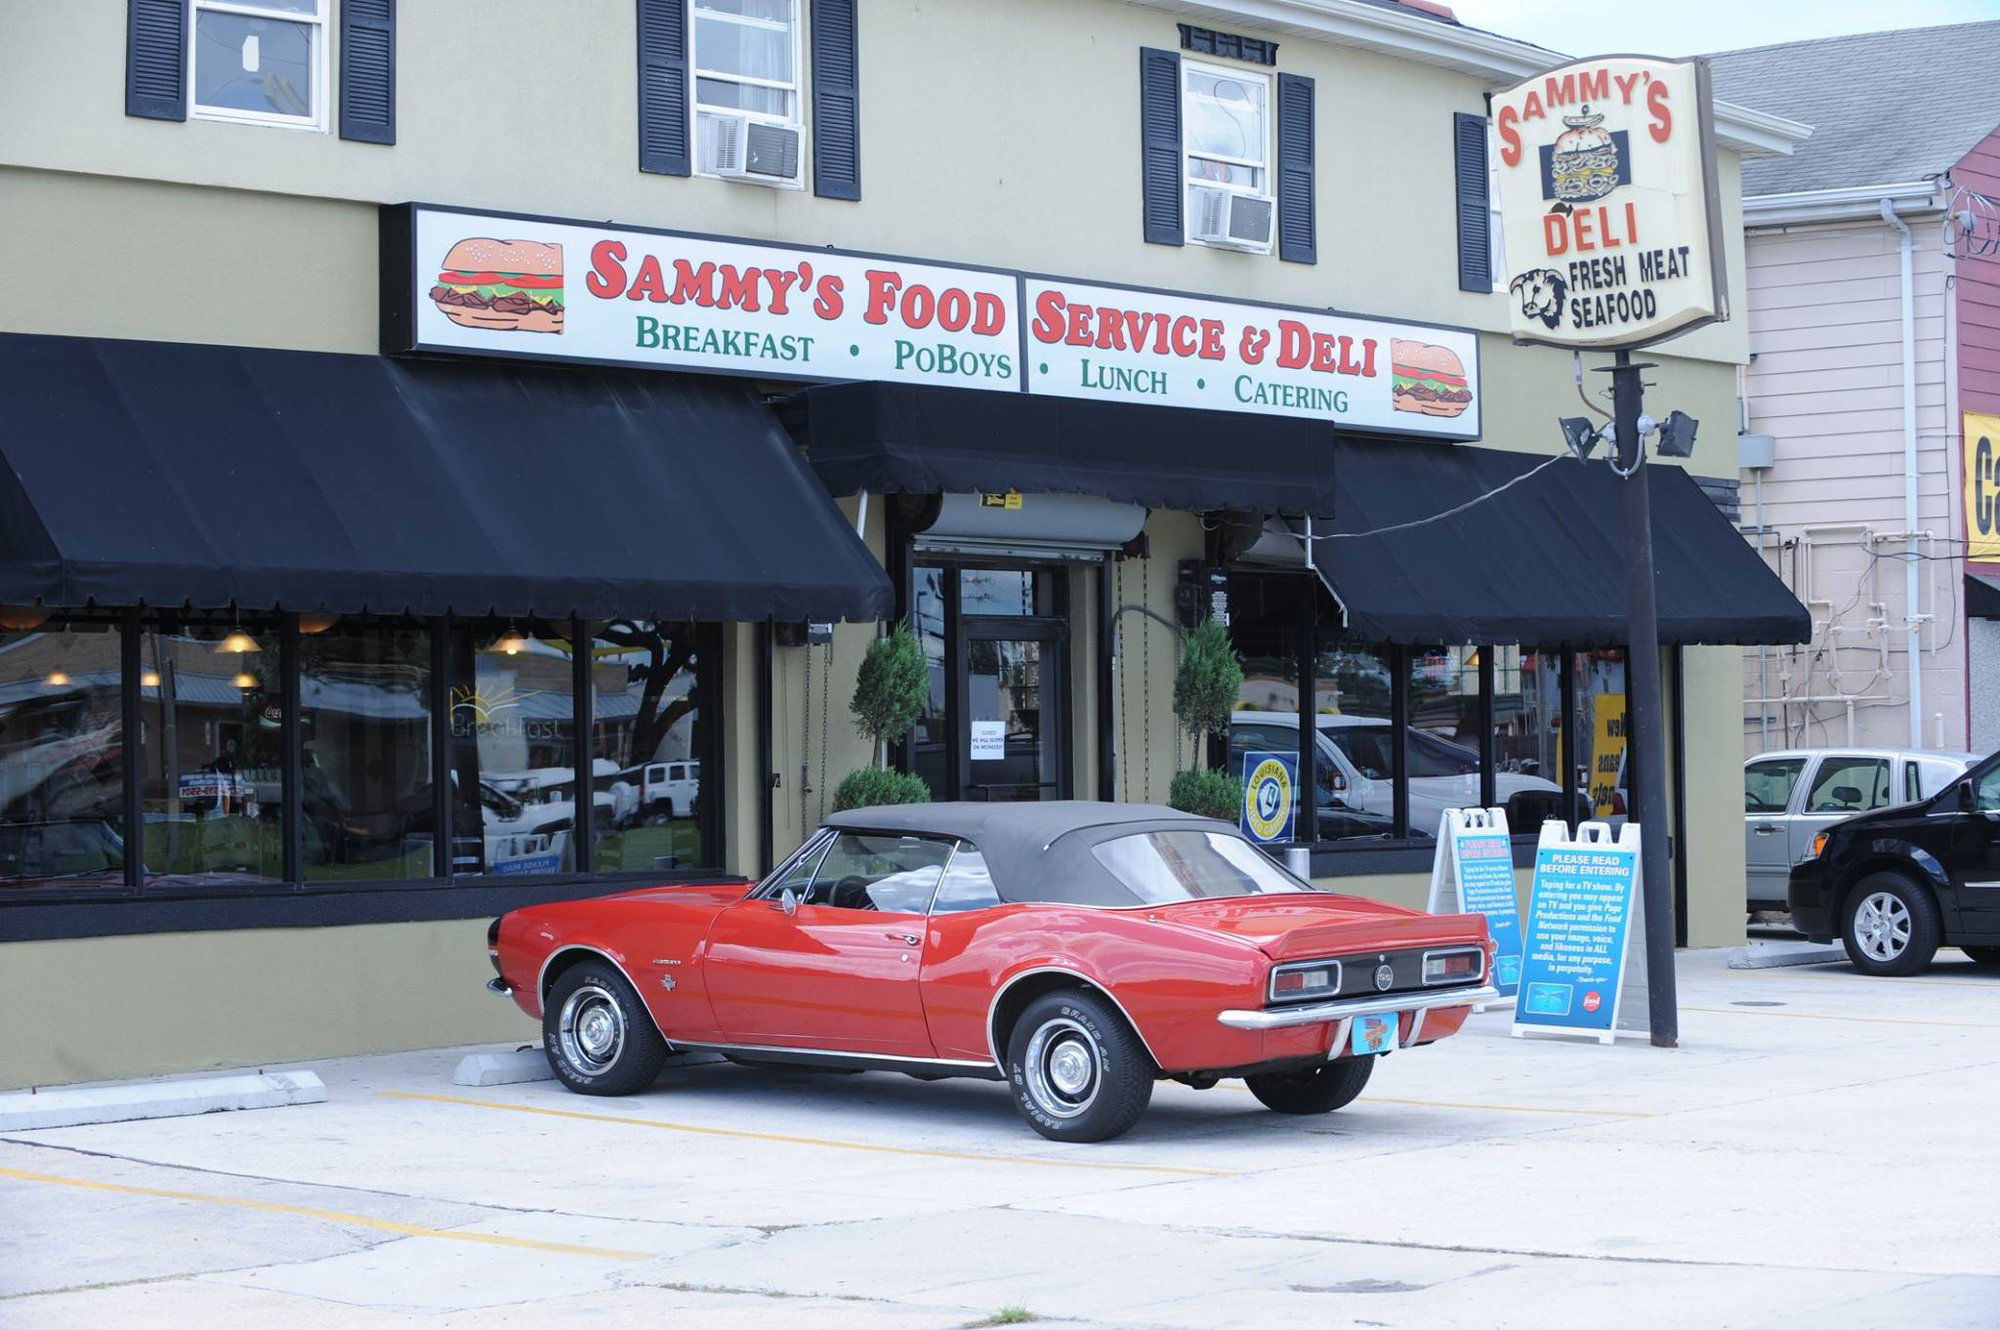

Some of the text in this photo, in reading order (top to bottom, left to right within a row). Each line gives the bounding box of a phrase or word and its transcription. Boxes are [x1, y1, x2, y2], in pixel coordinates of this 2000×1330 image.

[1498, 68, 1672, 167] SAMMY'S
[1543, 202, 1638, 256] DELI
[1569, 246, 1690, 292] FRESH MEAT
[585, 239, 1378, 378] SAMMY'S FOOD SERVICE & DELI
[1571, 289, 1656, 329] SEAFOOD
[636, 315, 815, 363] BREAKFAST
[1080, 358, 1168, 395] LUNCH
[1233, 374, 1349, 413] CATERING
[1251, 763, 1288, 790] LOUISIANA
[1540, 863, 1630, 877] BEFORE ENTERING
[1552, 854, 1620, 866] PLEASE READ
[1541, 879, 1564, 890] Taping
[1583, 881, 1592, 890] TV
[1549, 900, 1558, 909] TV
[1060, 1006, 1102, 1041] GRAND
